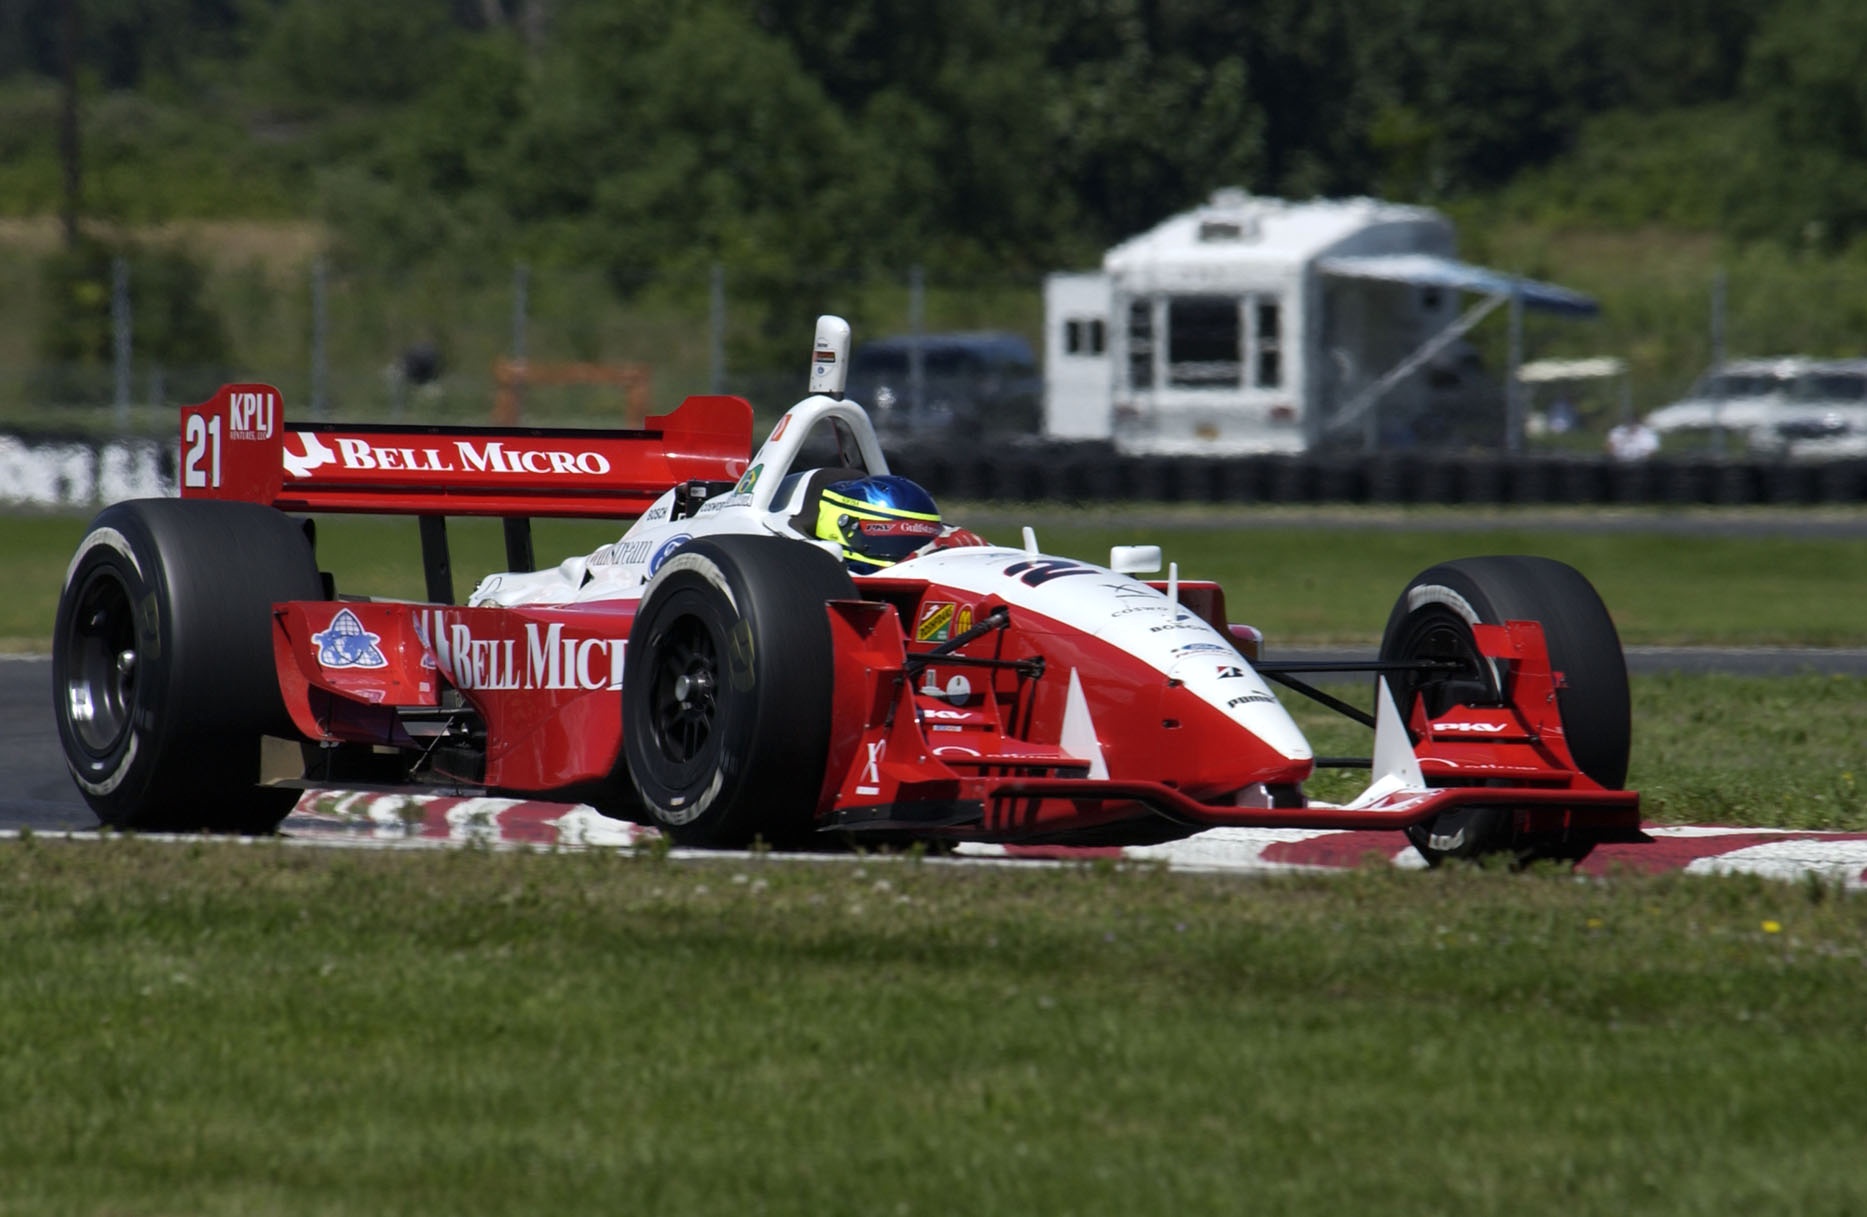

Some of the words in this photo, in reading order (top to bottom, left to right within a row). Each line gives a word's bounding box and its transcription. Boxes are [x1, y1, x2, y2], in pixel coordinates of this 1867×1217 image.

[230, 393, 274, 439] KPLJ
[185, 413, 220, 487] 21
[335, 438, 453, 471] BELL
[453, 441, 611, 474] MICRO
[451, 624, 520, 690] BELL
[923, 709, 973, 719] KV
[1433, 722, 1507, 733] PKV
